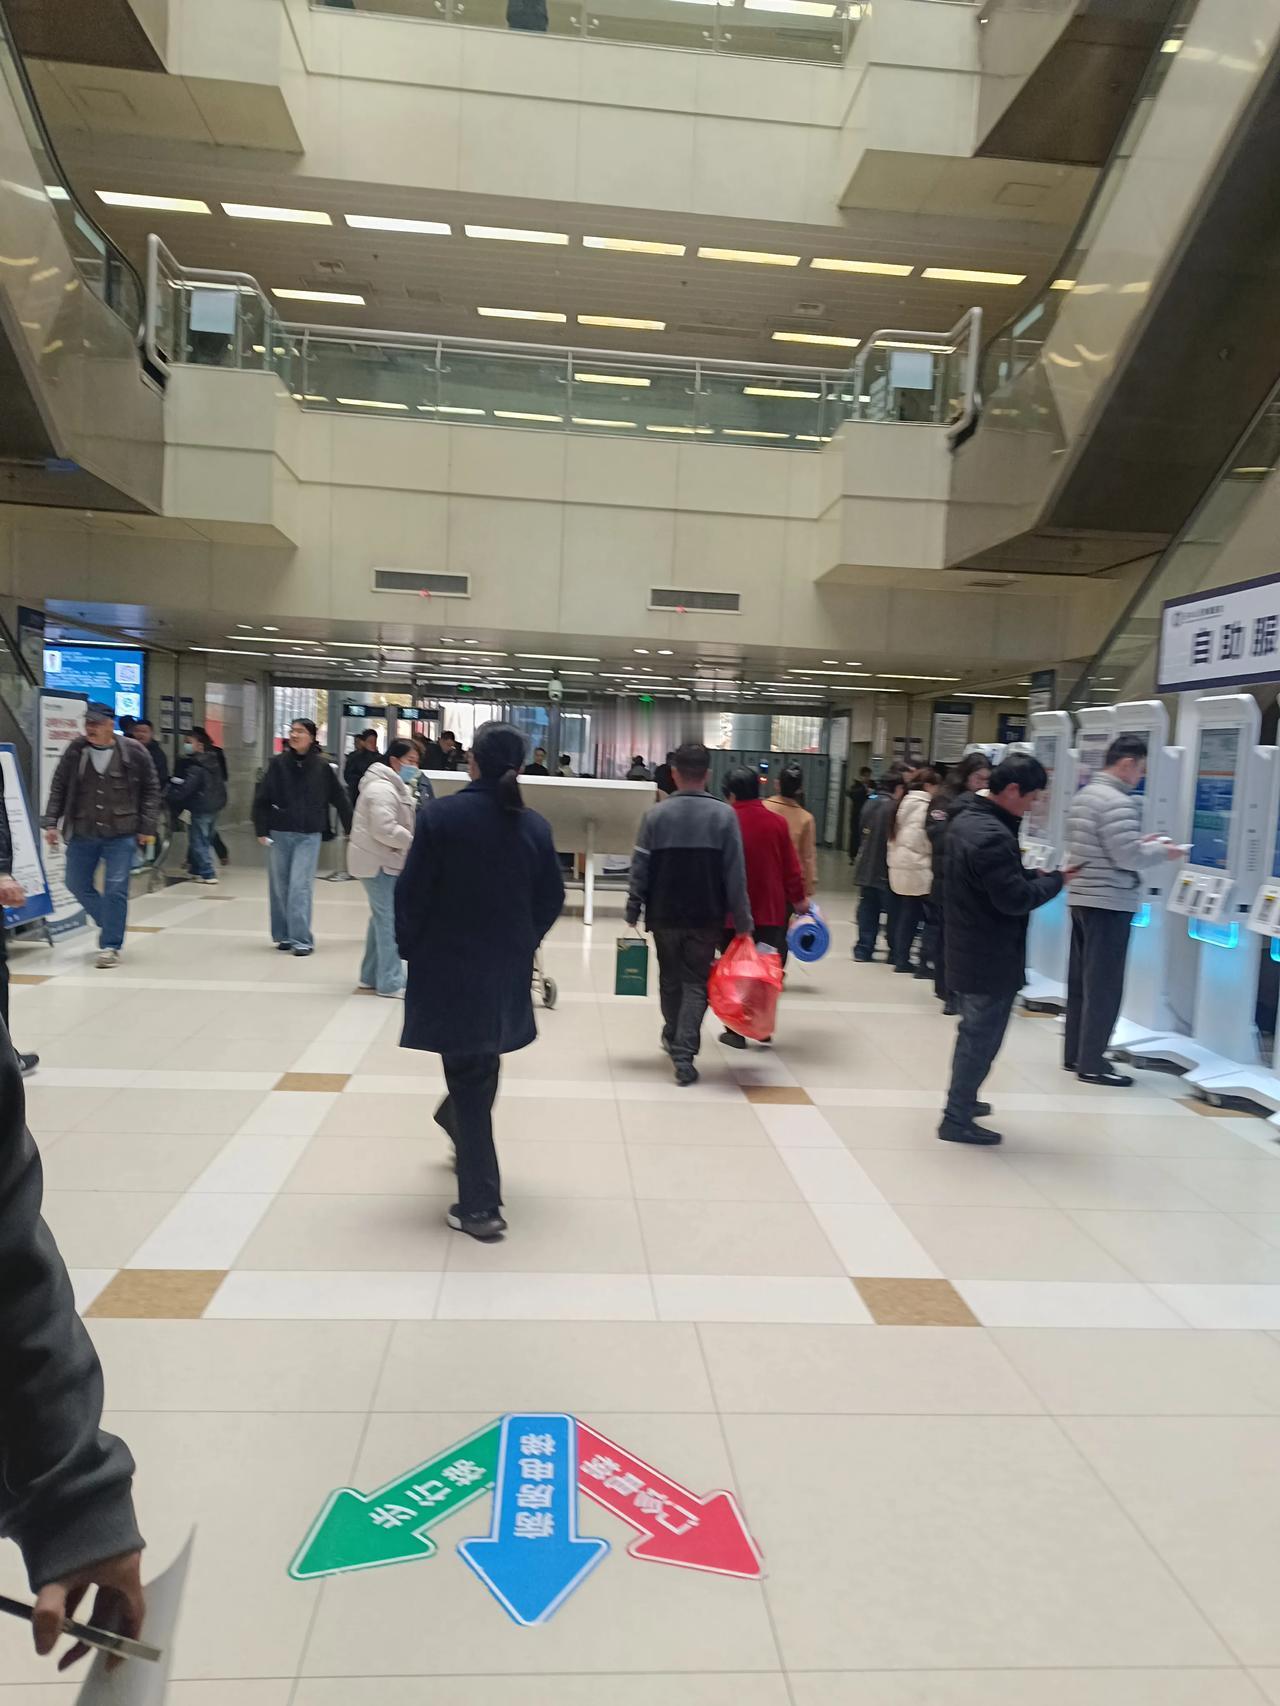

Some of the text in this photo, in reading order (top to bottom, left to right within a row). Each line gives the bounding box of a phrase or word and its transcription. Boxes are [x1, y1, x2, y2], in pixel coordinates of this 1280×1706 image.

[368, 1459, 487, 1528] 步行梯
[513, 1433, 556, 1538] 病房电梯
[579, 1454, 700, 1535] 门诊电梯
